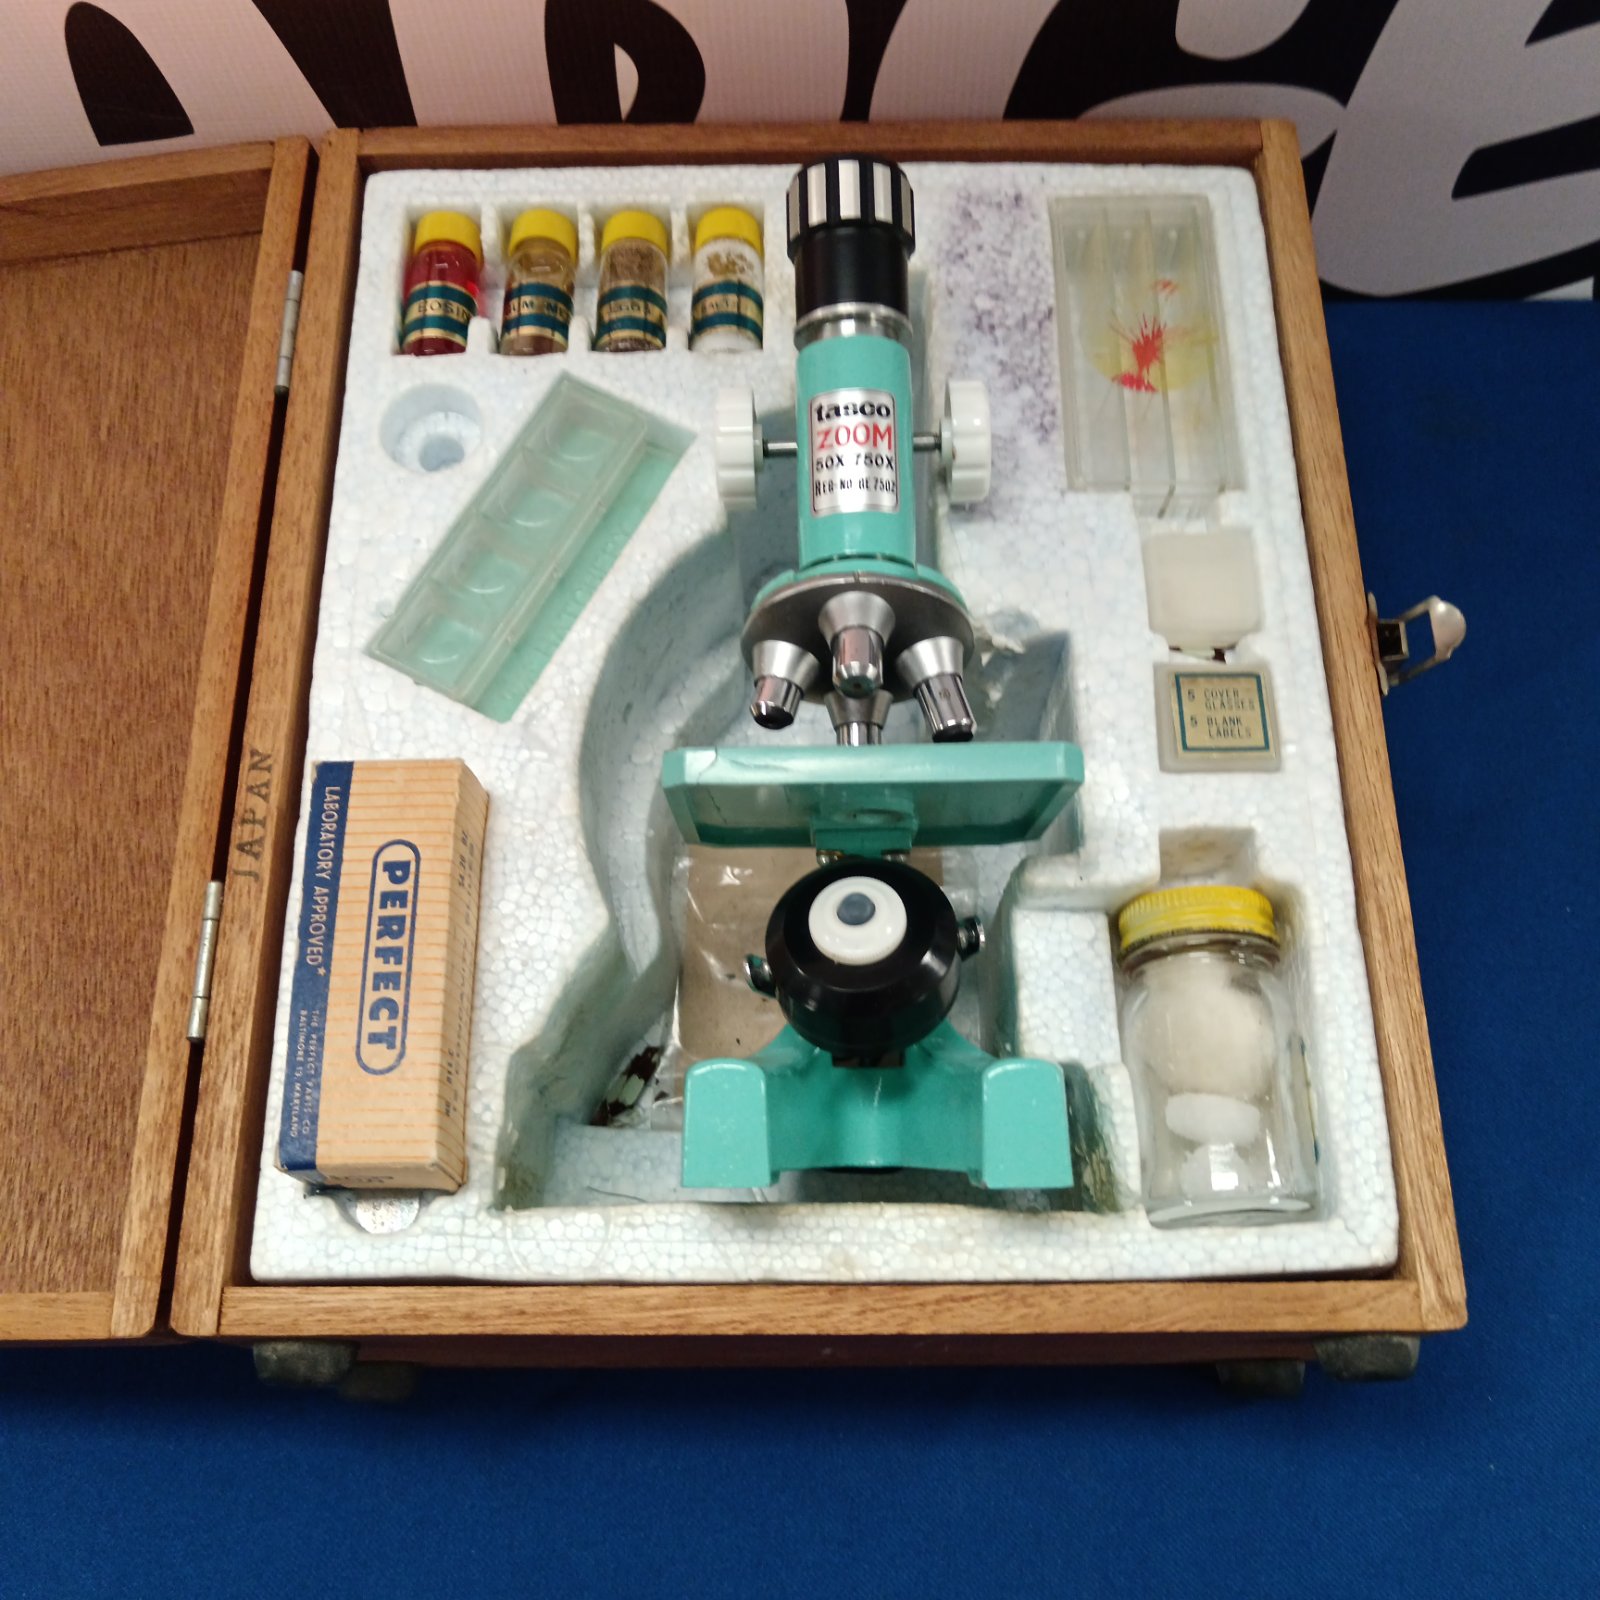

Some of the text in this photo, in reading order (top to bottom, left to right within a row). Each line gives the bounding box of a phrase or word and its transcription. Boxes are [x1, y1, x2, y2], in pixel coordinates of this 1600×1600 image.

[417, 299, 472, 321] EOSIN
[816, 402, 891, 422] tasco
[816, 423, 892, 451] ZOOM
[816, 453, 844, 472] 50X
[1187, 687, 1239, 702] 5 COVER
[1204, 698, 1255, 711] GLASSES
[1190, 715, 1243, 728] 5 BLANK
[1208, 727, 1252, 739] LABELS
[232, 750, 273, 884] JAPAN
[314, 786, 340, 880] LABORATORY
[367, 860, 411, 1050] PERFECT
[310, 1009, 320, 1028] THE
[296, 1009, 307, 1062] BALTIMORE
[306, 1033, 318, 1075] PERFECT
[289, 1082, 301, 1137] MARYLAND
[303, 1081, 314, 1113] PARTS
